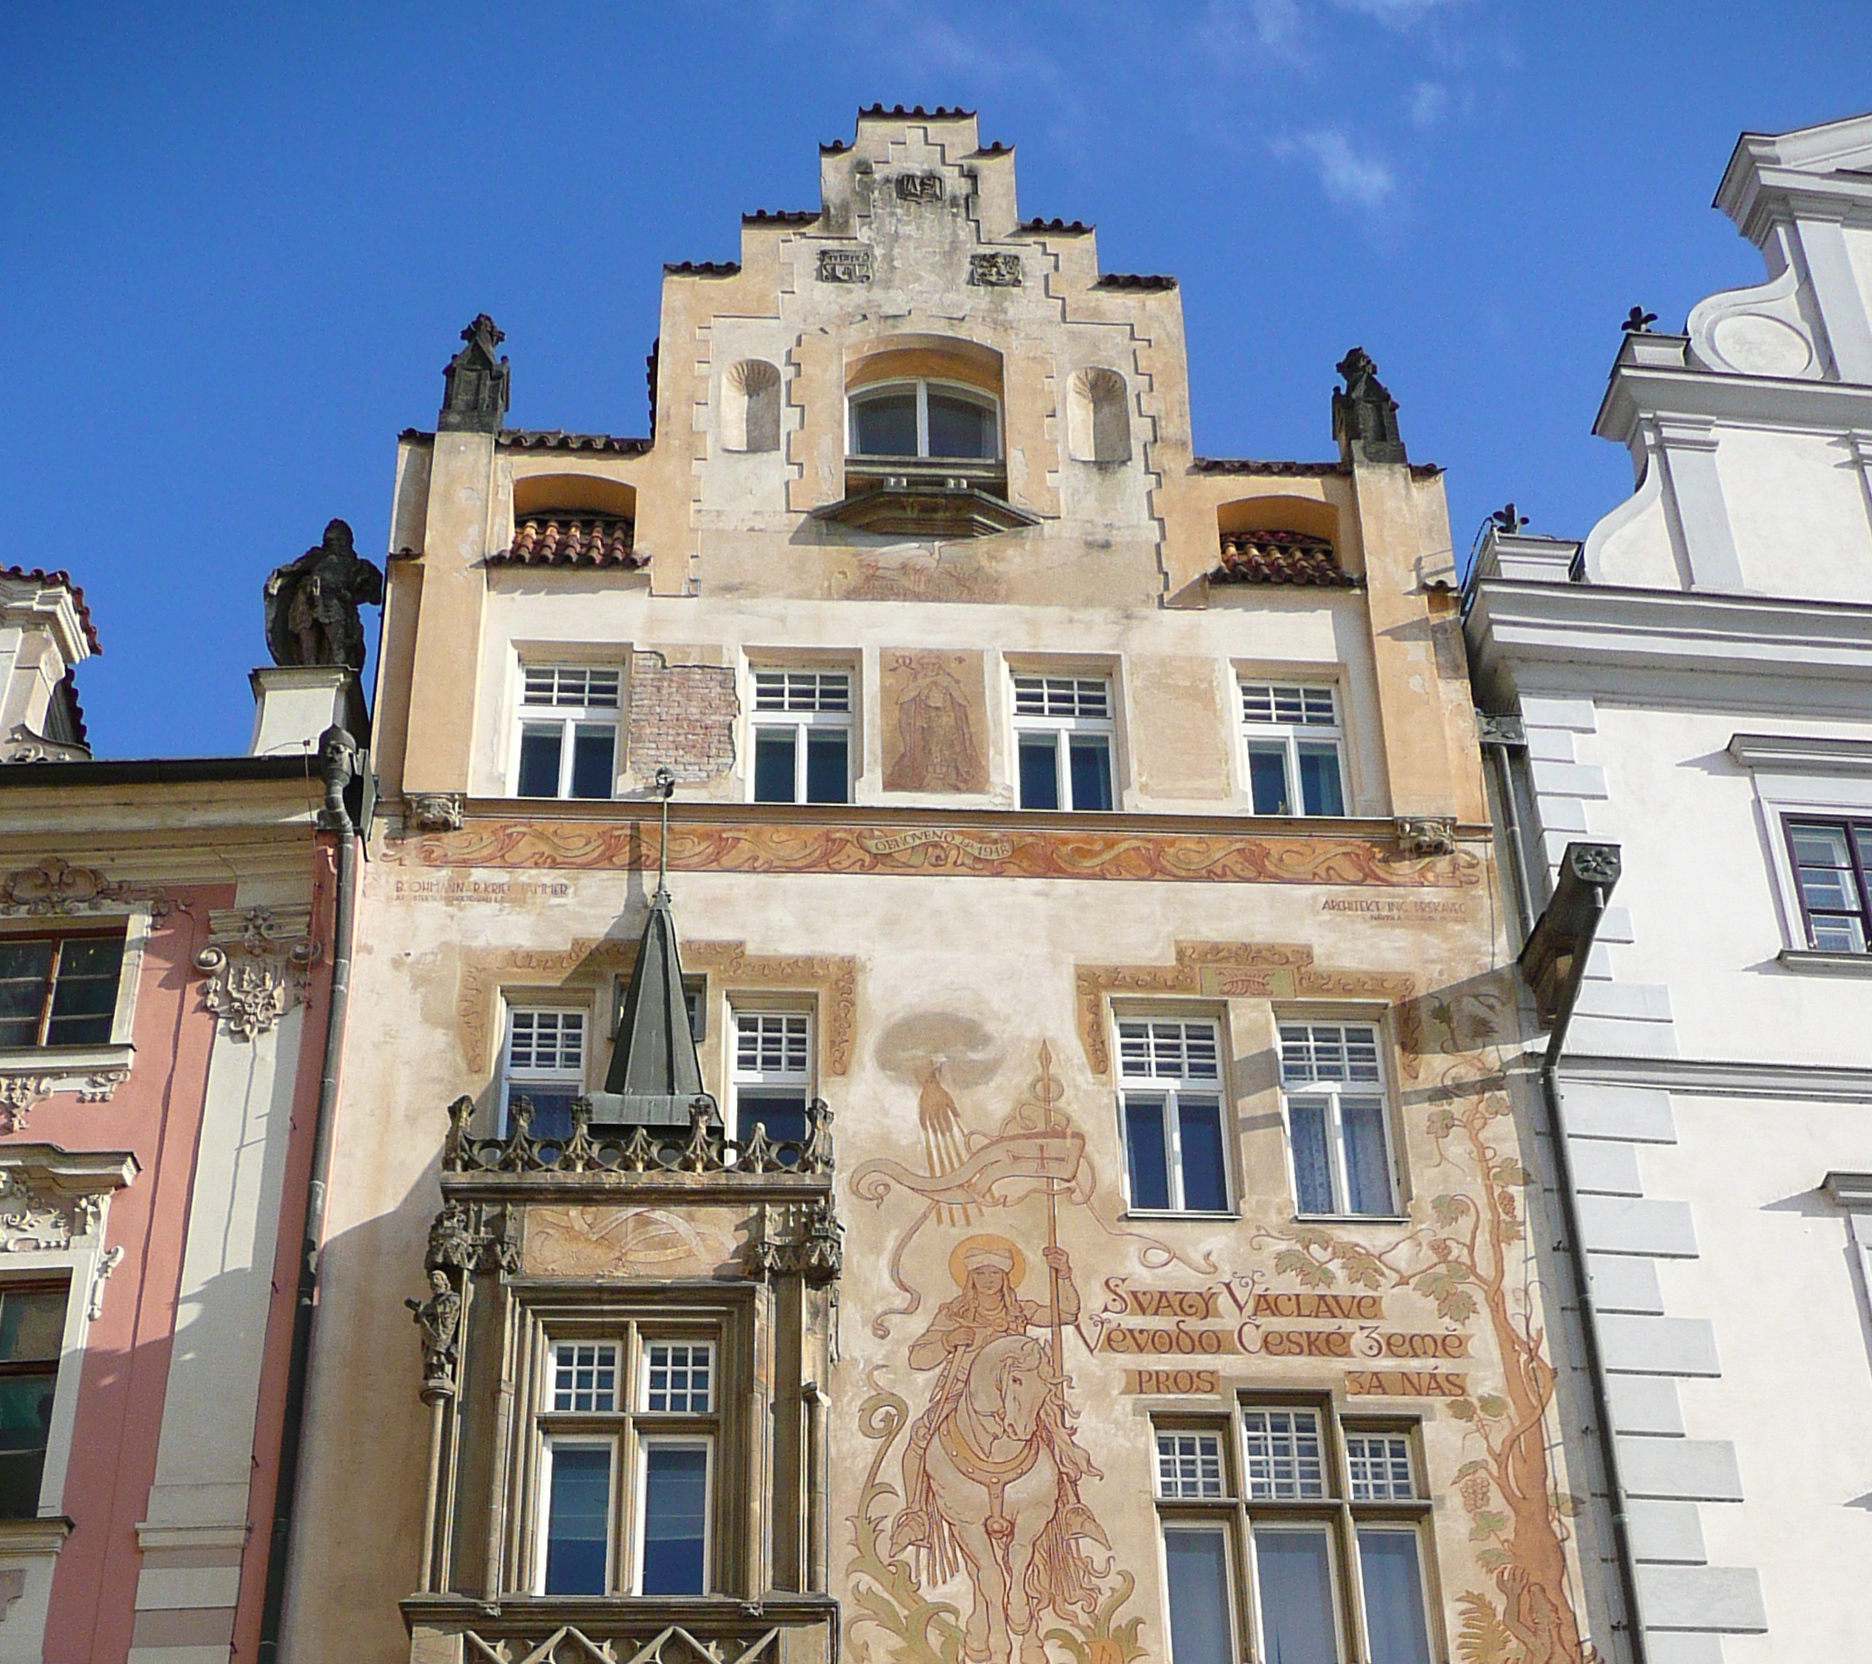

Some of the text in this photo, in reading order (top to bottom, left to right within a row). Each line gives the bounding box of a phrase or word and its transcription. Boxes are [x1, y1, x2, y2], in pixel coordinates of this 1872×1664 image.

[875, 829, 955, 852] OBNOVENO
[1137, 1369, 1215, 1394] PROS
[1399, 1366, 1467, 1398] NÁS
